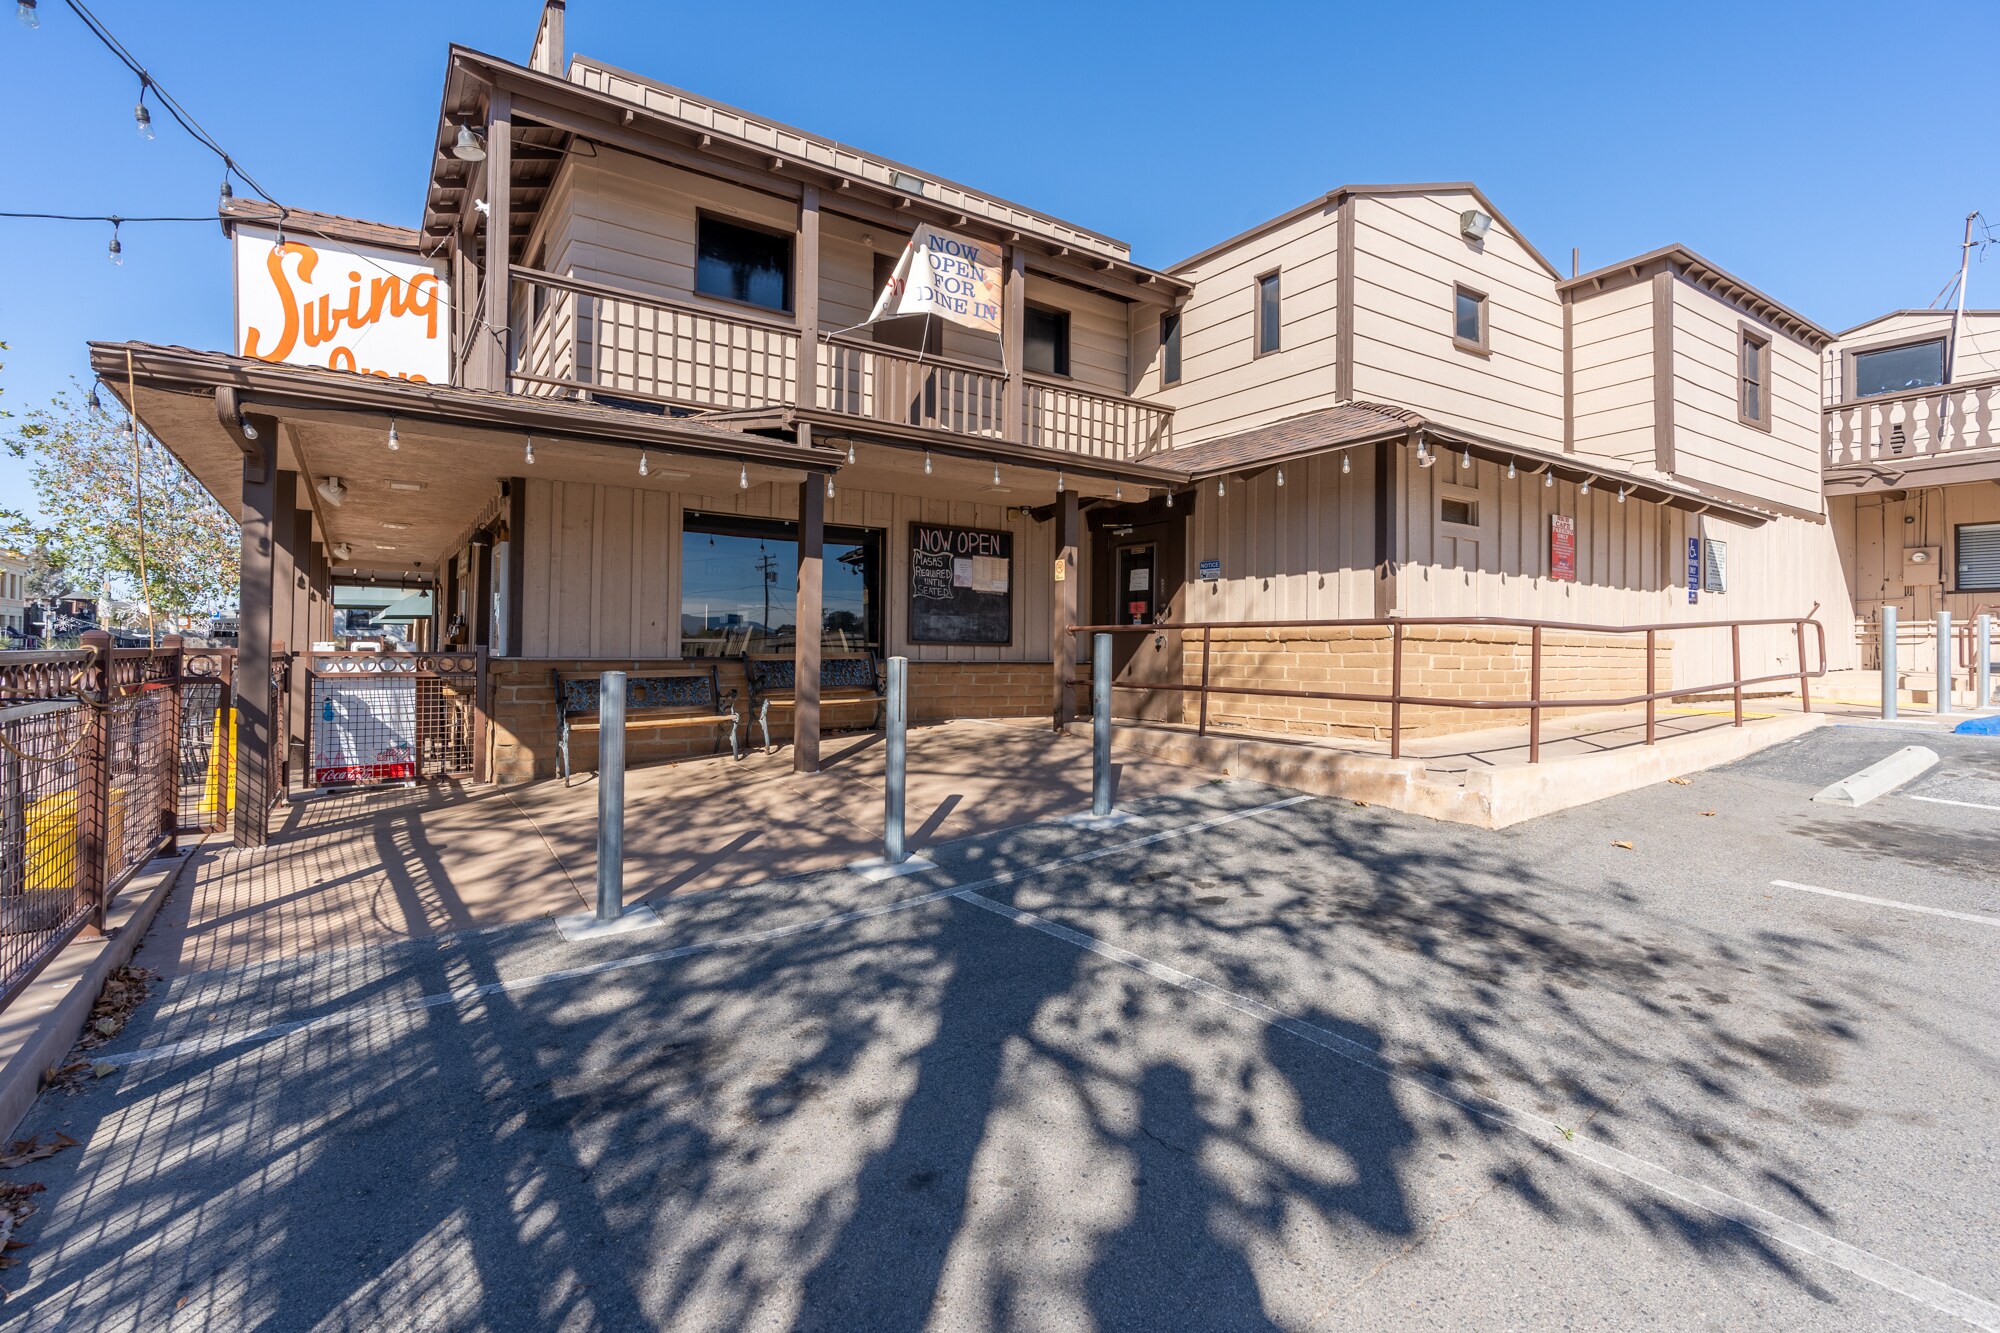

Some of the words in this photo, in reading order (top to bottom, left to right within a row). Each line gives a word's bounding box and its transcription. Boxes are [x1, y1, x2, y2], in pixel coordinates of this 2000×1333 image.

[928, 234, 980, 261] NOW
[928, 254, 985, 283] OPEN
[933, 272, 976, 298] FOR
[243, 240, 439, 364] Swing
[916, 286, 968, 315] DINE
[972, 301, 998, 321] IN
[919, 528, 953, 552] NOW
[957, 531, 1000, 555] OPEN
[915, 552, 944, 567] MASKS
[1200, 561, 1219, 569] NOTICE
[915, 566, 952, 579] REQUIRED
[924, 578, 946, 587] UNTIL
[917, 585, 950, 596] SEATED
[321, 767, 372, 782] Coca-Cola
